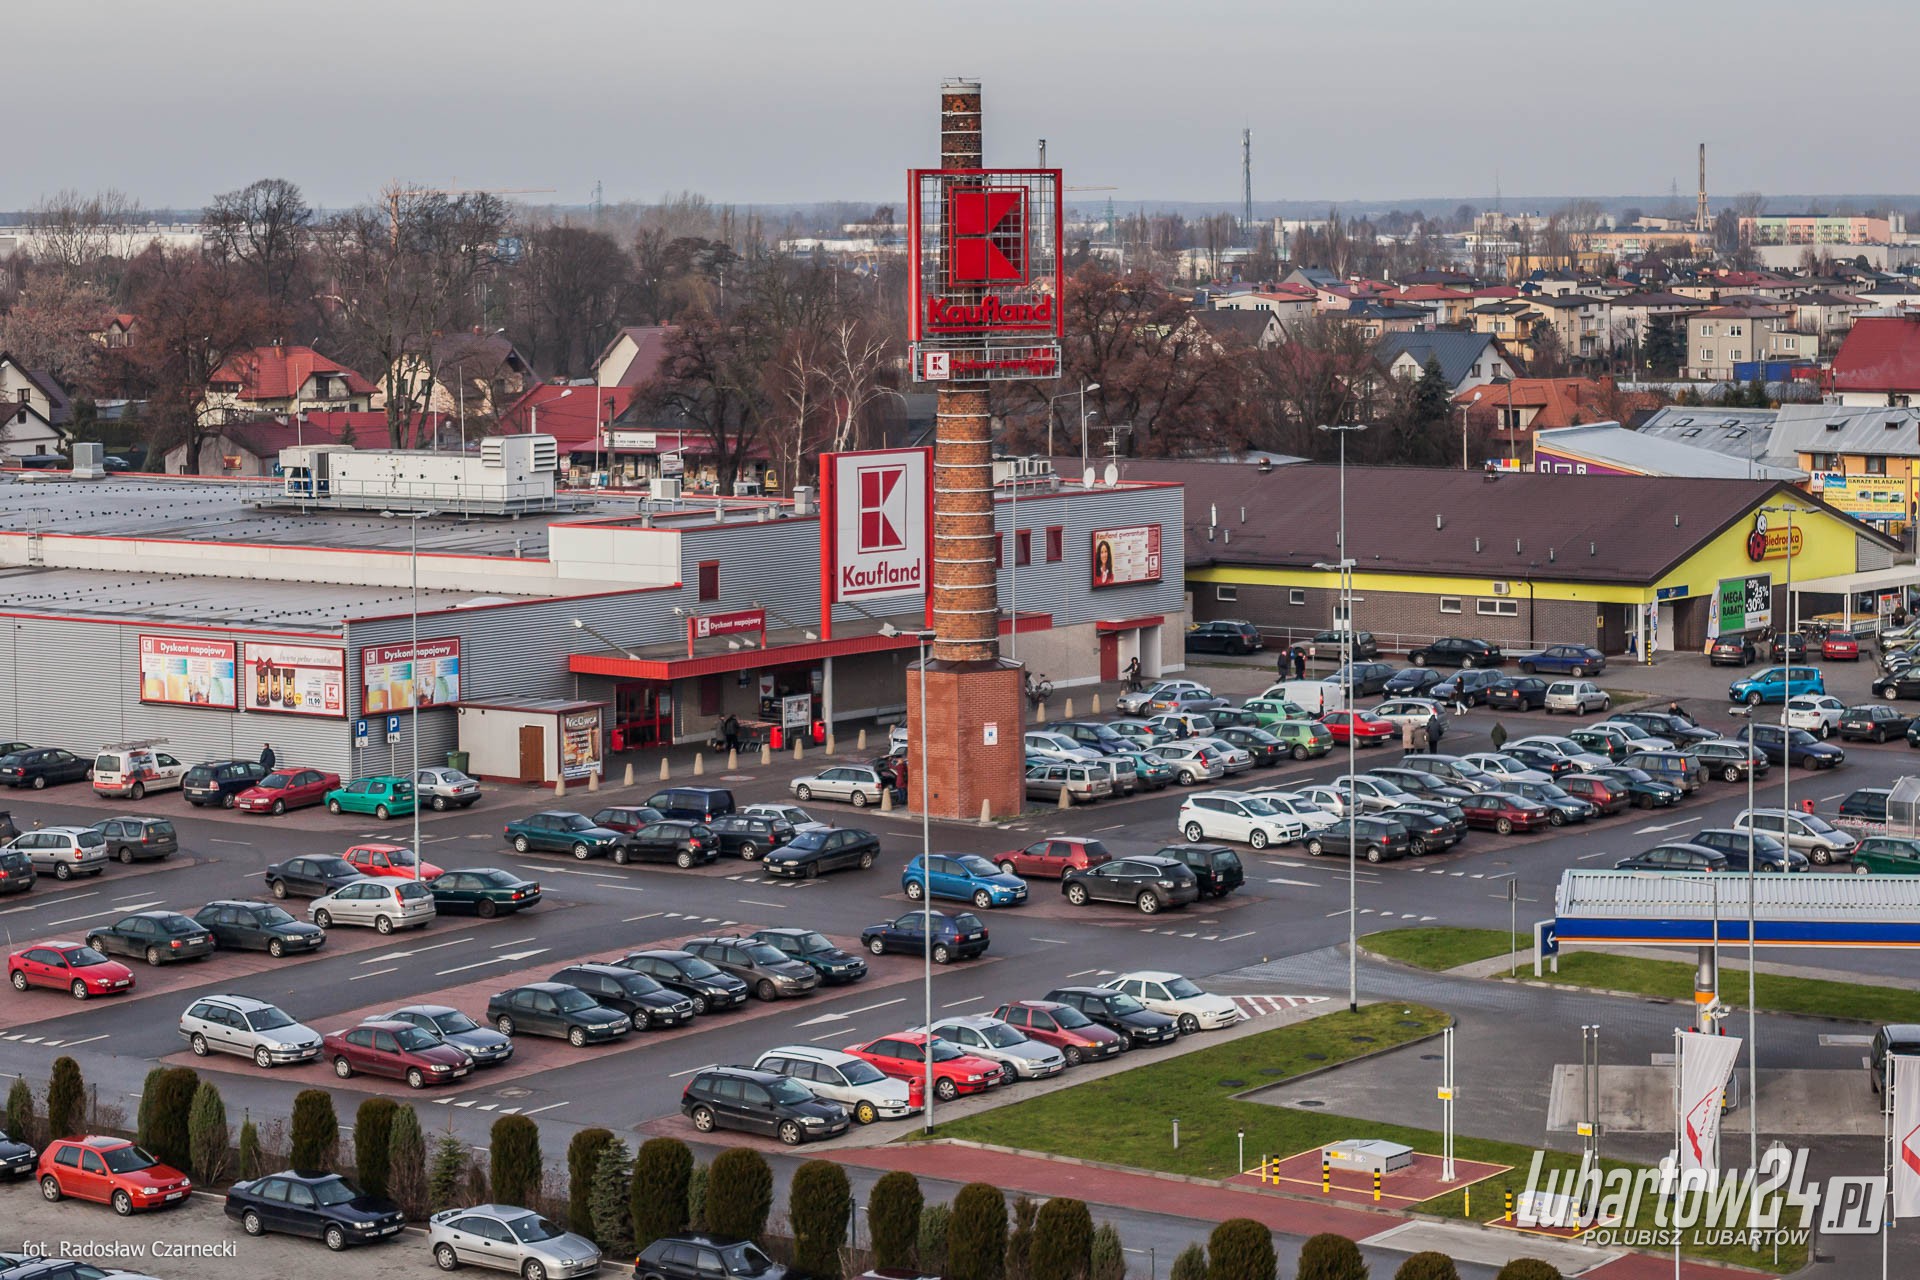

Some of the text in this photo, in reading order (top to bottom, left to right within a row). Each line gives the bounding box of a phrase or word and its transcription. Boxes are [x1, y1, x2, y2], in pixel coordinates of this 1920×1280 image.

[928, 294, 1052, 324] Kaufland
[843, 558, 920, 588] Kaufland
[1723, 591, 1743, 604] MEGA
[1752, 585, 1769, 597] -25%
[1723, 604, 1743, 616] RABATY
[1746, 598, 1765, 612] -30%
[710, 621, 733, 630] Dyskont
[734, 618, 761, 627] napojowy
[160, 642, 189, 653] Dyskont
[190, 646, 226, 657] napojowy
[384, 649, 414, 661] Dyskont
[416, 645, 451, 657] napojowy
[358, 721, 366, 735] P
[390, 717, 398, 731] P
